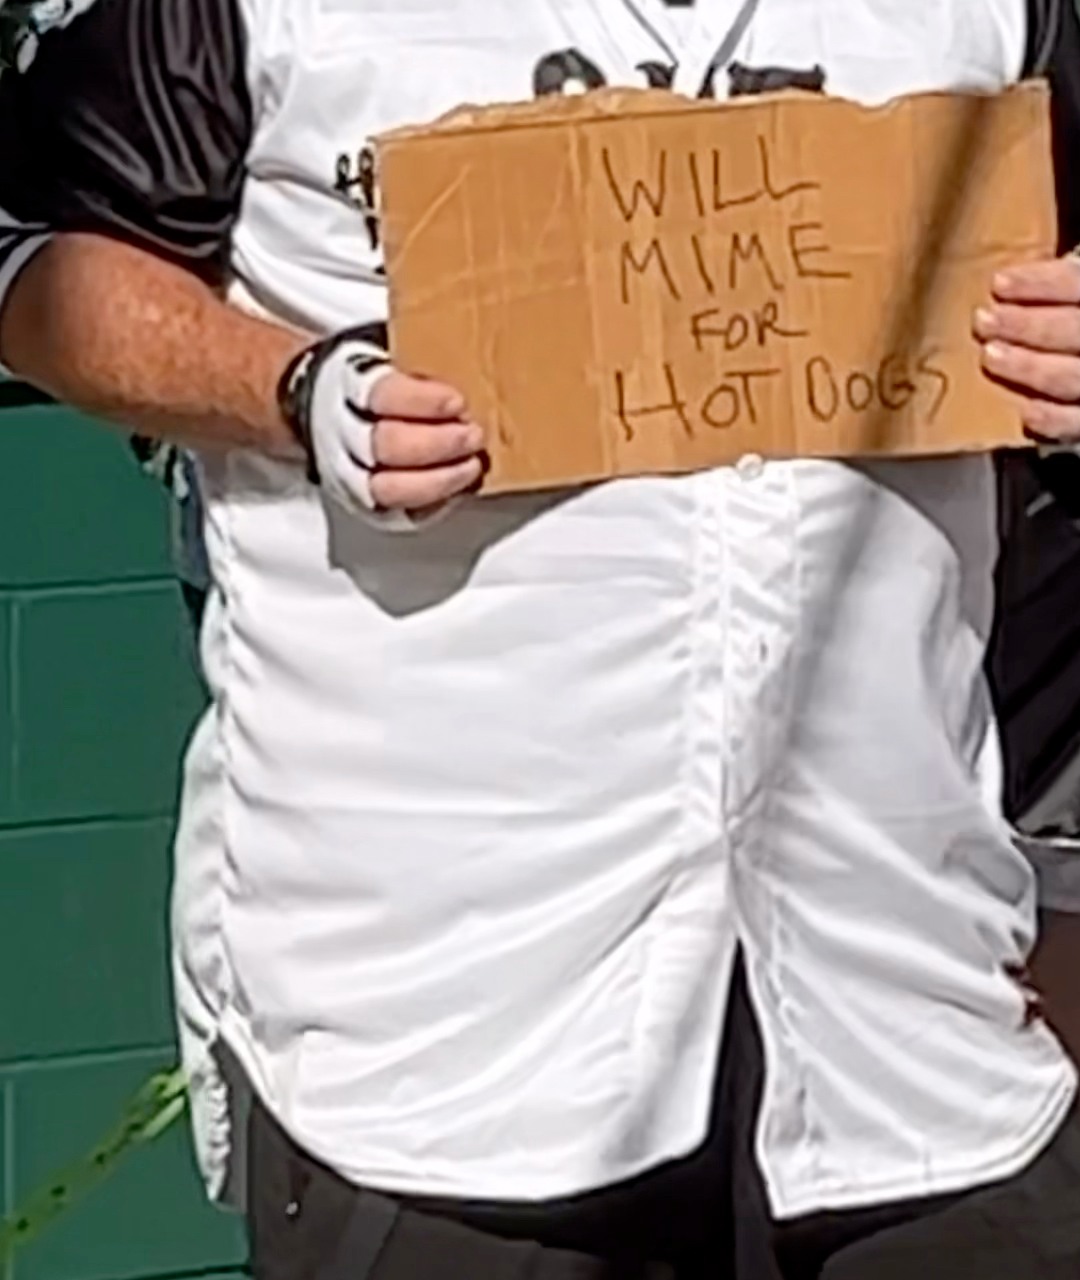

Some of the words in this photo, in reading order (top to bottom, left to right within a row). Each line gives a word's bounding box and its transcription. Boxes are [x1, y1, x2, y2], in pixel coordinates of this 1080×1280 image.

[601, 134, 821, 223] WILL
[619, 222, 852, 305] MIME
[691, 302, 810, 352] FOR
[613, 361, 781, 443] HOT
[806, 354, 951, 424] DOGS
